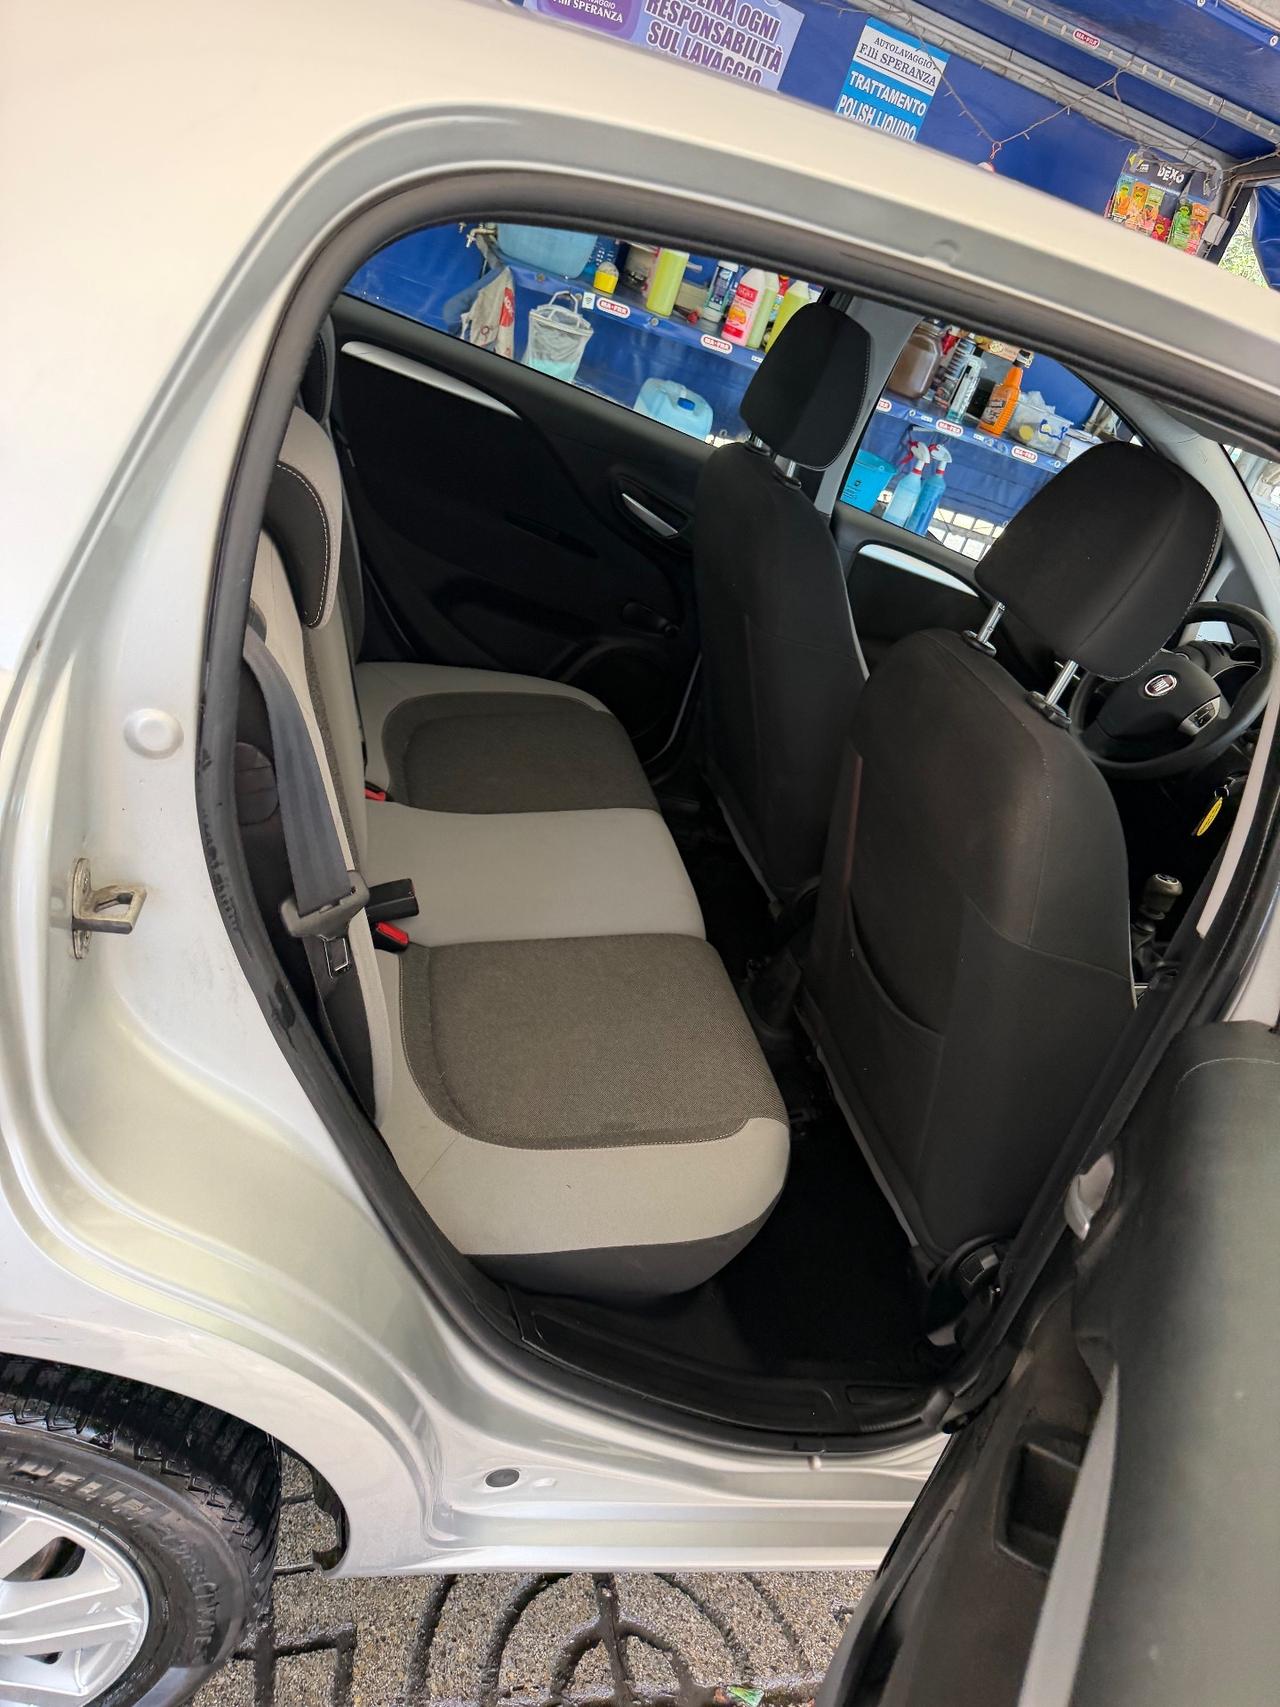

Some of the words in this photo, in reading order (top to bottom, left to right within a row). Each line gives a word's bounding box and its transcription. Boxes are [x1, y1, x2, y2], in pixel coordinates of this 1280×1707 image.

[572, 1, 623, 23] SPERANZA
[736, 4, 781, 42] OGNI
[645, 0, 784, 73] RESPONSABILITÀ
[647, 20, 680, 55] SUL
[874, 37, 933, 69] AUTOLAVAGGIO
[858, 43, 879, 60] F.lli
[879, 52, 937, 87] SPERANZA
[849, 70, 927, 117] TRATTAMENTO
[836, 94, 877, 126] POLISH
[875, 111, 917, 143] LIQUIDO
